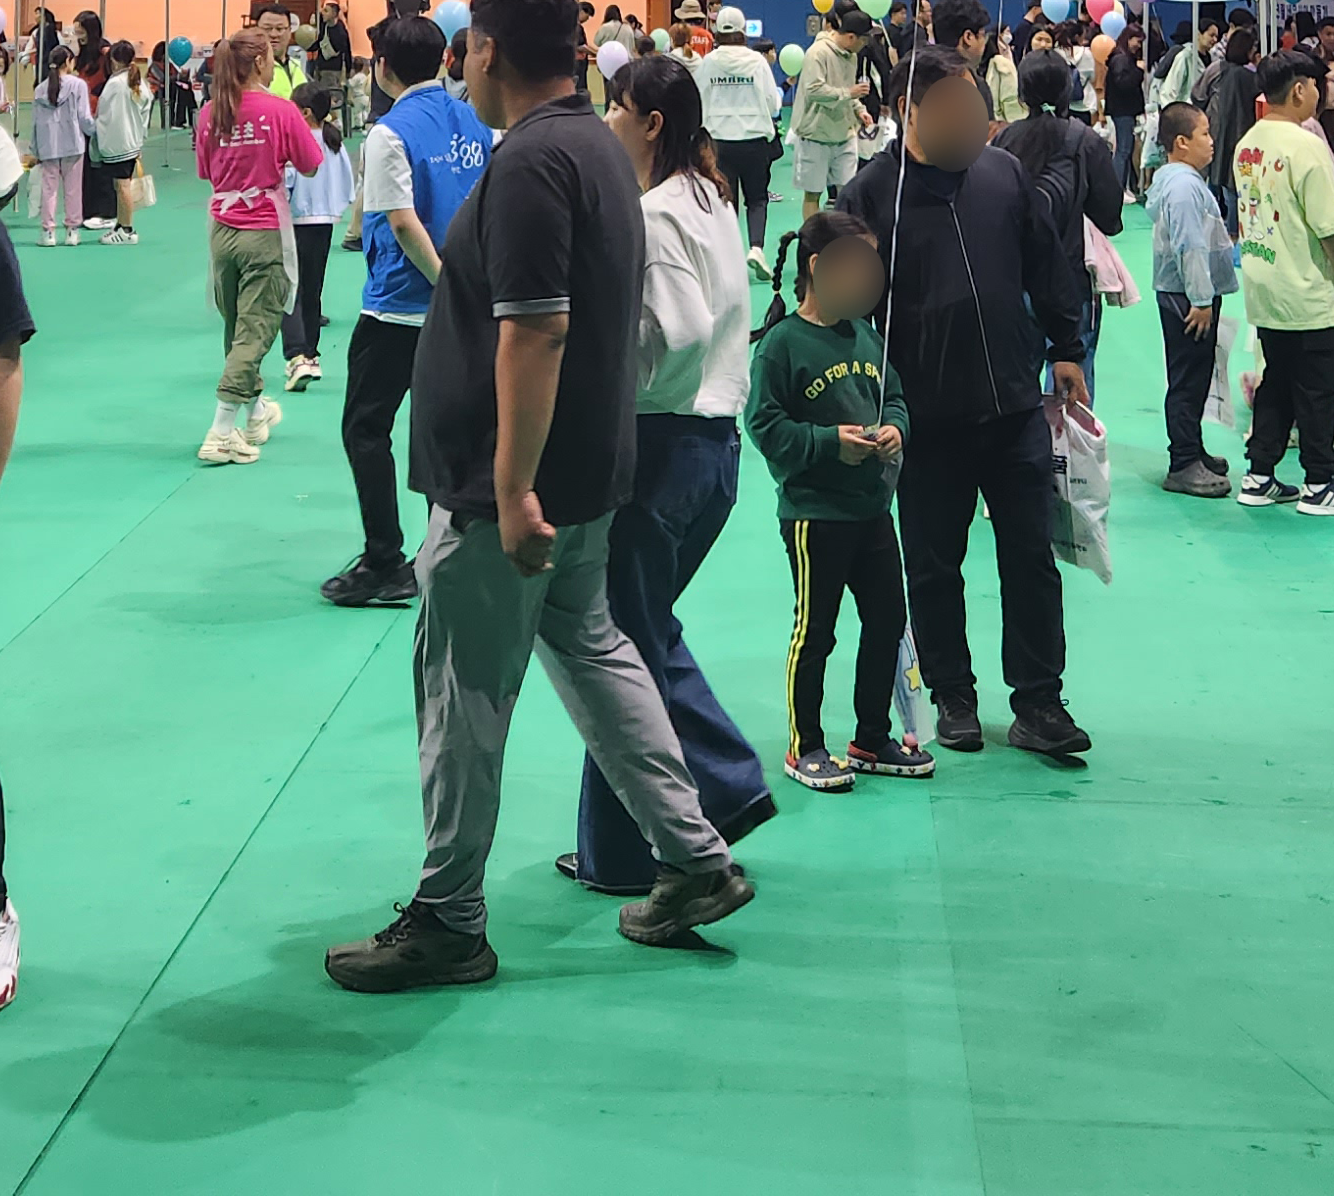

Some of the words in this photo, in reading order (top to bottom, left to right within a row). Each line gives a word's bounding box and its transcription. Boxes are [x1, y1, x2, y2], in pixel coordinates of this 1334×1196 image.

[804, 377, 826, 400] GO
[824, 362, 850, 384] FOR
[851, 360, 861, 374] A
